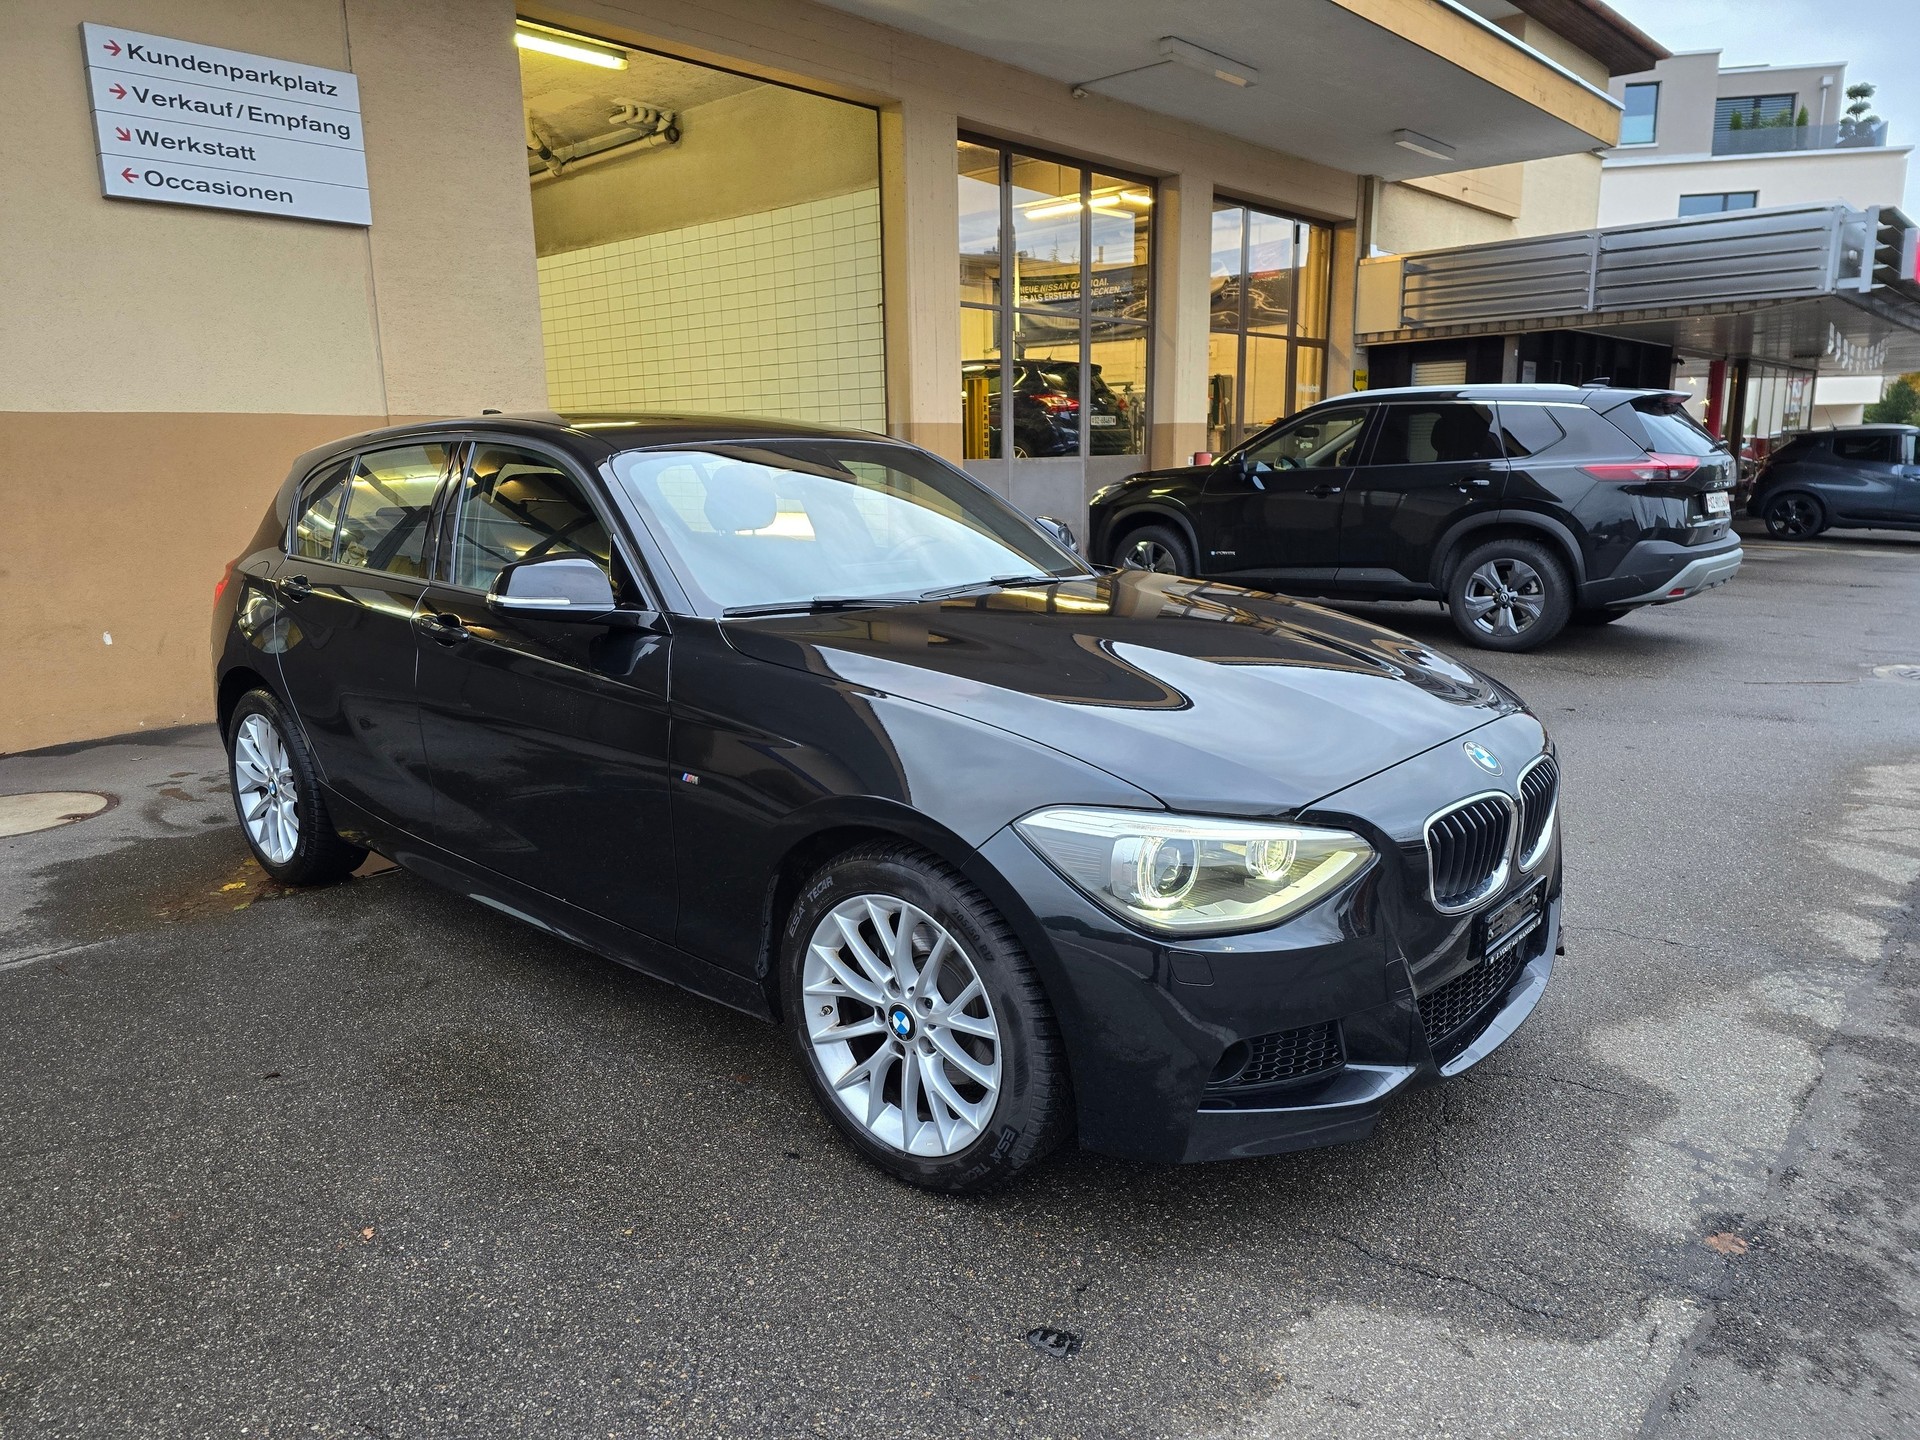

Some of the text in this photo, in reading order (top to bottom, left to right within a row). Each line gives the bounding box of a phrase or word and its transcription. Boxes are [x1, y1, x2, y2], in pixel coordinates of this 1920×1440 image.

[127, 43, 339, 97] Kundenparkplatz
[131, 86, 351, 140] Verkauf/Empfang
[135, 128, 257, 162] Werkstatt
[144, 170, 293, 204] Occasionen
[1030, 293, 1043, 302] ALS
[1045, 290, 1072, 300] ERSTER
[1040, 282, 1069, 293] NISSAN
[807, 876, 834, 902] TECAR
[952, 908, 995, 962] 205/50 R17
